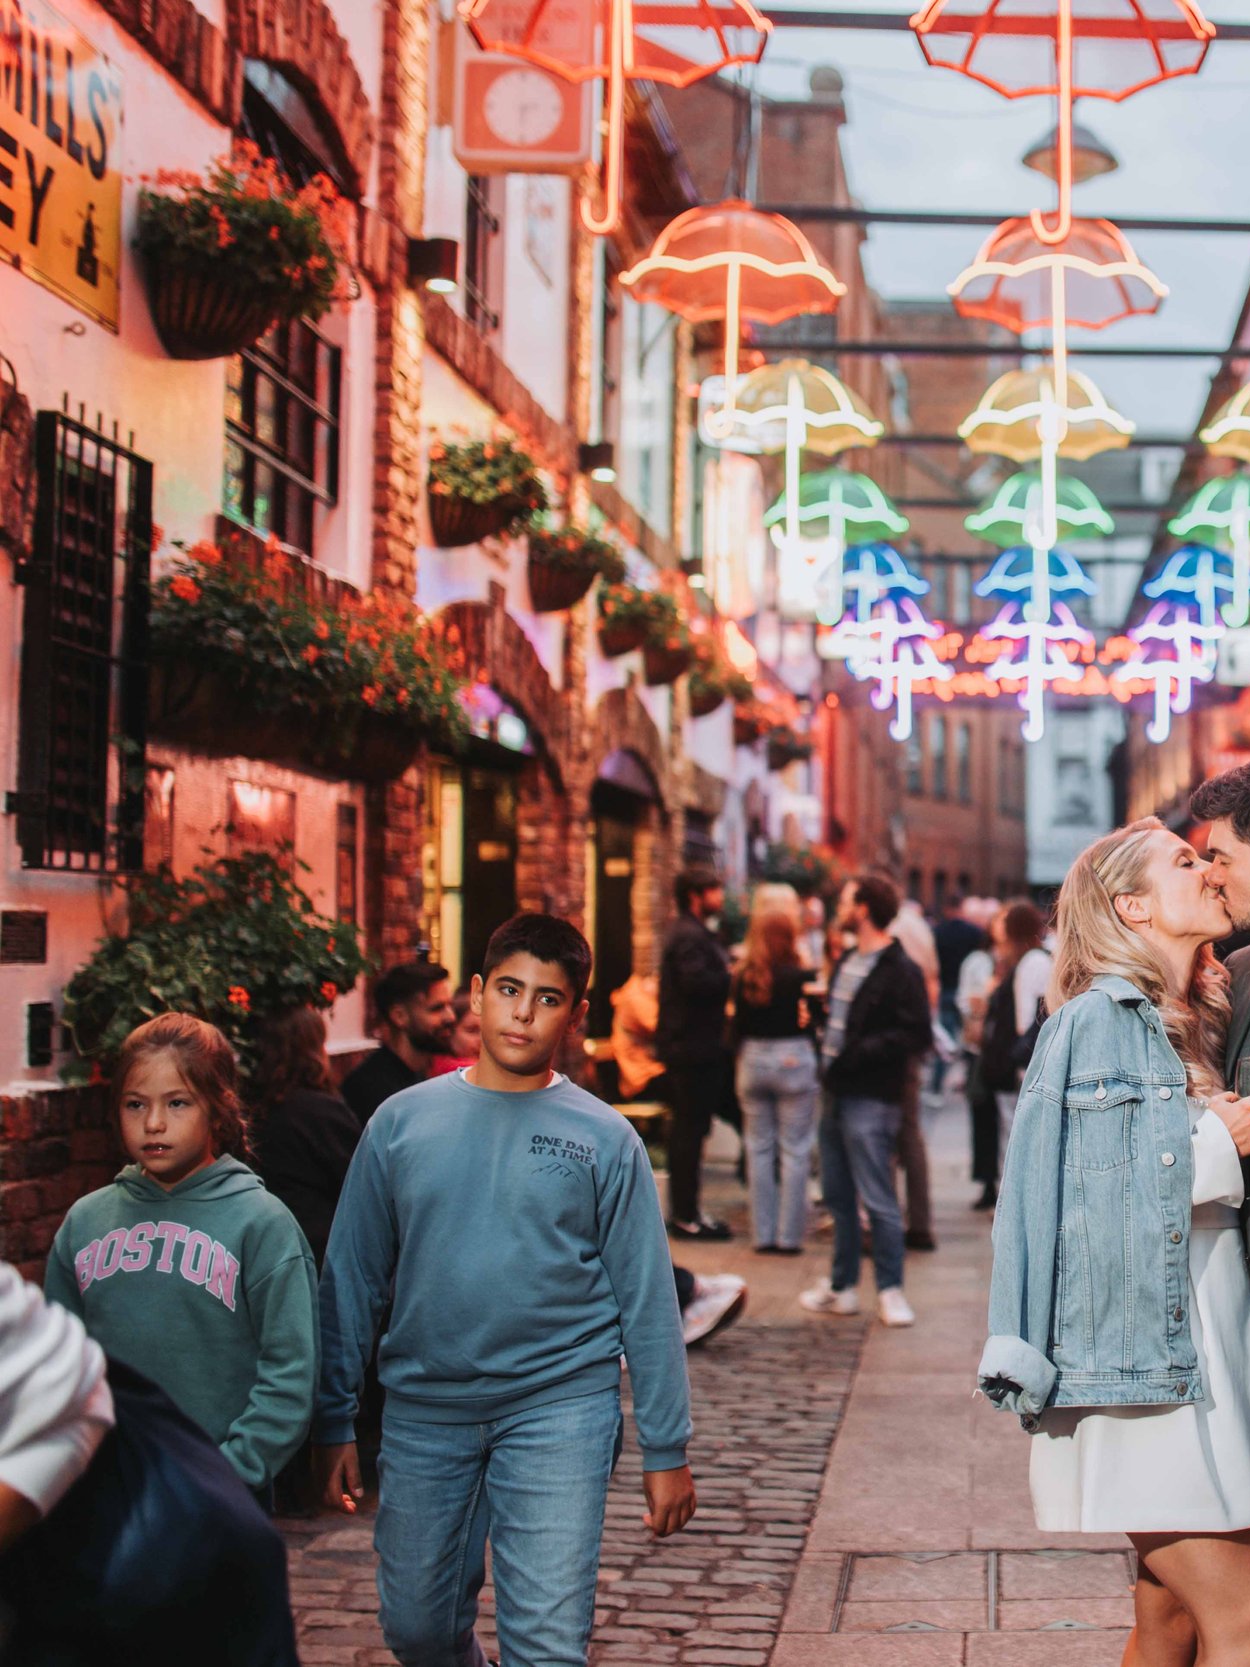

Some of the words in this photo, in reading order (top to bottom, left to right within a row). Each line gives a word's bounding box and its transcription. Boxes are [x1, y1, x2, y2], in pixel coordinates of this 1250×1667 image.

[531, 1135, 562, 1147] ONE
[565, 1140, 595, 1155] DAY
[528, 1146, 545, 1154] AT
[547, 1148, 557, 1157] A
[561, 1149, 593, 1166] TIME
[74, 1221, 240, 1312] BOSTON
